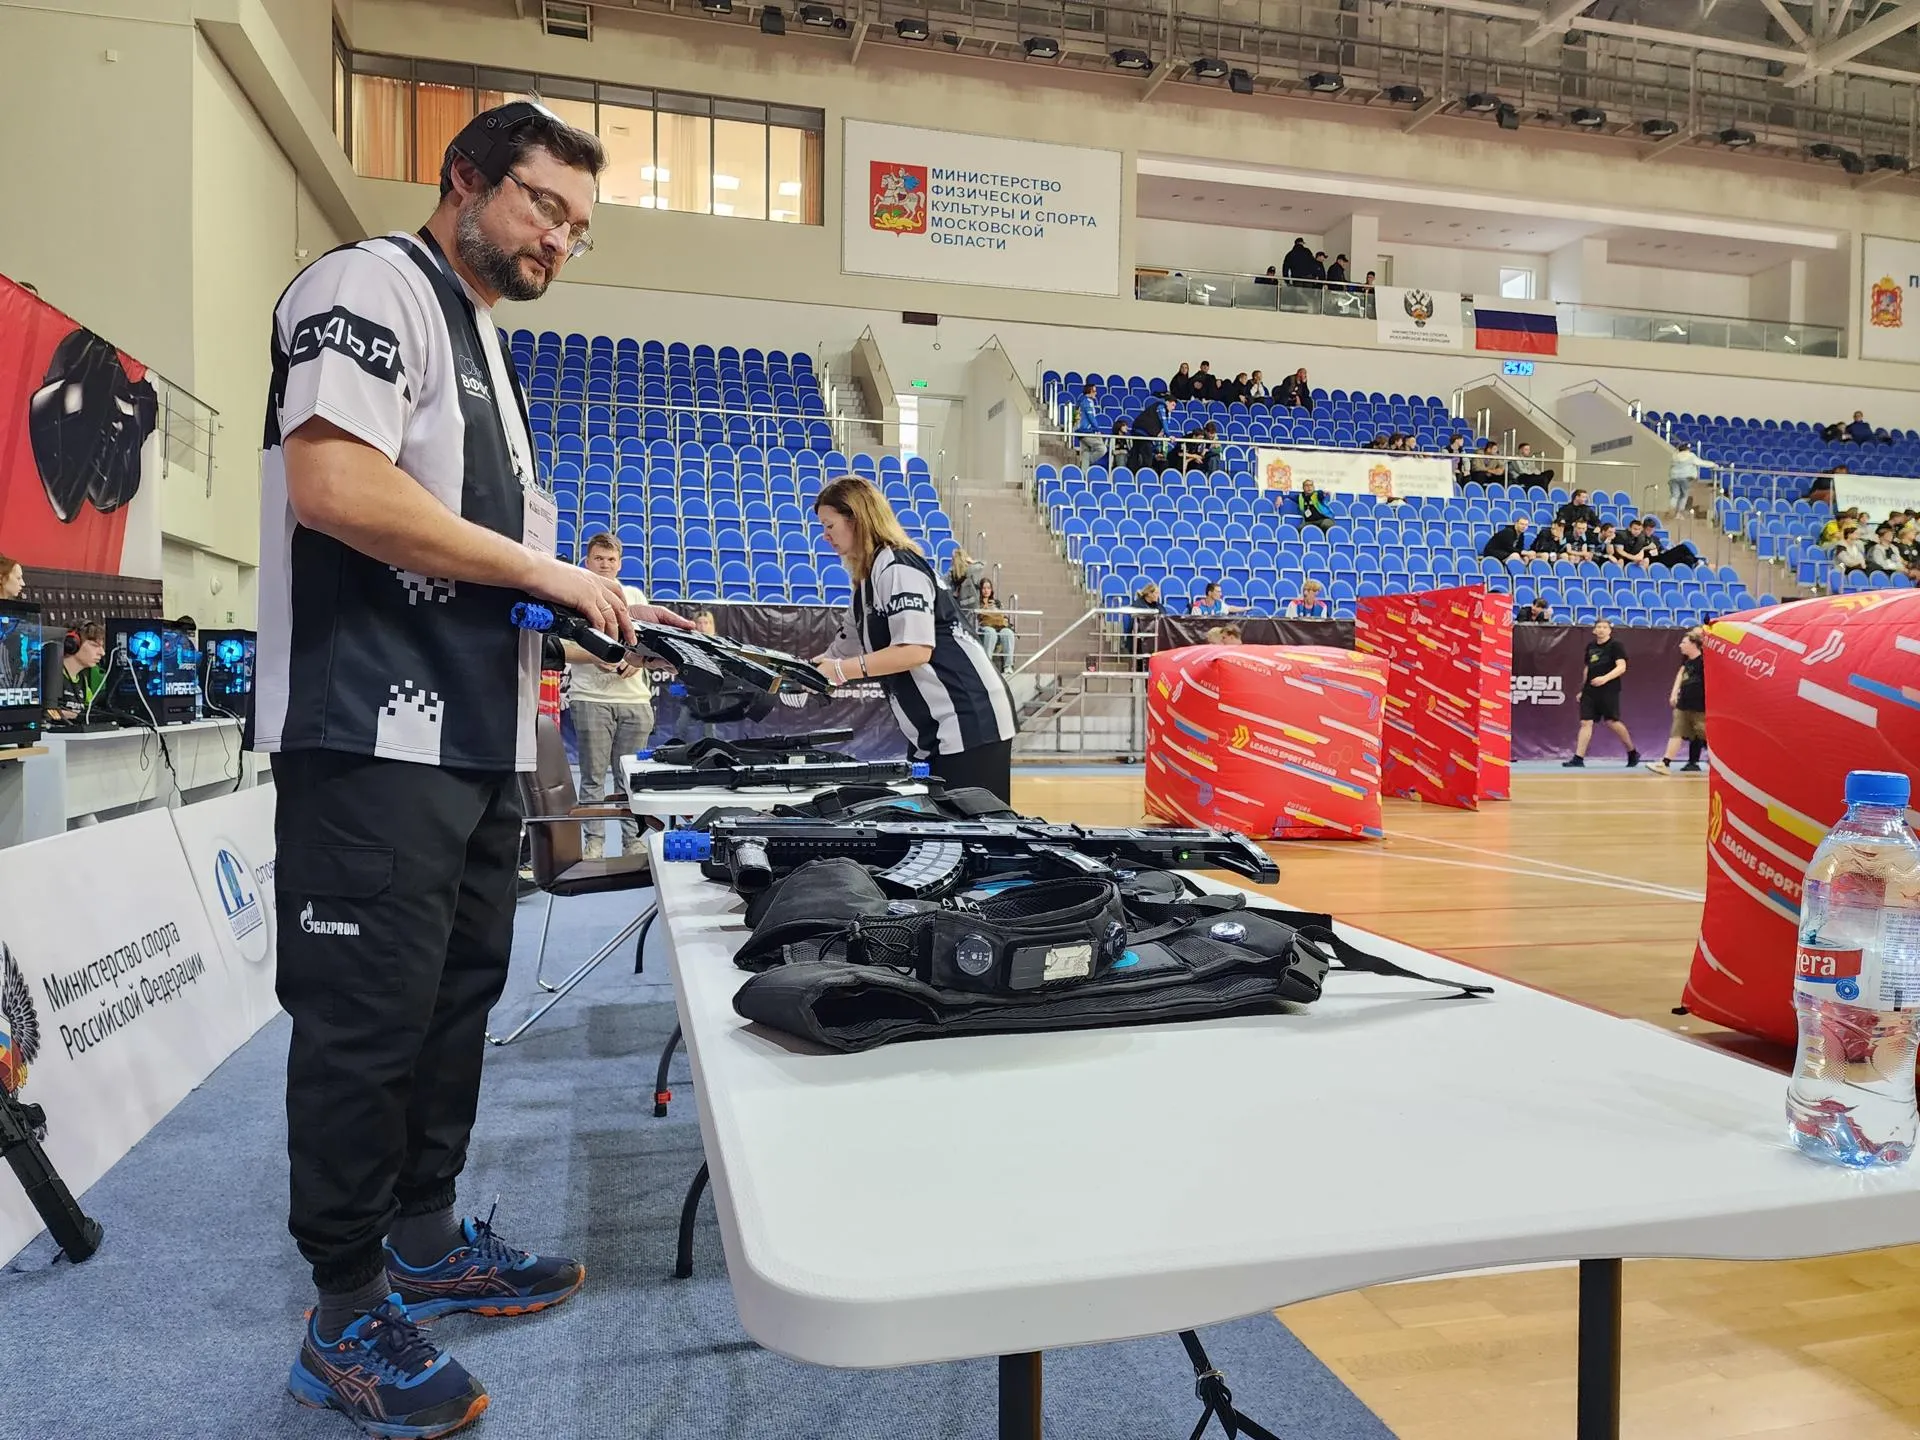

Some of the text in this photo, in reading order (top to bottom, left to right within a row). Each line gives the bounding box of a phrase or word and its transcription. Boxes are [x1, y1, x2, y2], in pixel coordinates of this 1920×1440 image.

[931, 168, 1062, 192] МИНИСТЕРСТВО
[931, 184, 1043, 207] ФИЗИЧЕСКОЙ
[931, 200, 1097, 228] КУЛЬТУРЫ И СПОРТА
[931, 216, 1044, 239] МОСКОВСКОЙ
[931, 232, 1006, 250] ОБЛАСТИ
[293, 317, 397, 369] СУДЬЯ
[889, 596, 923, 611] УДЬЯ
[1728, 648, 1776, 677] СПОРТА
[651, 671, 676, 682] ОРТ
[165, 682, 195, 695] HYPERPC
[1249, 741, 1279, 757] LEAGUE
[255, 860, 275, 884] СПОР
[1721, 830, 1802, 898] LEAGUE SPORT
[314, 921, 360, 936] GAZPROM
[43, 922, 180, 1013] Министерство спорта
[59, 952, 206, 1061] Российской Федерации
